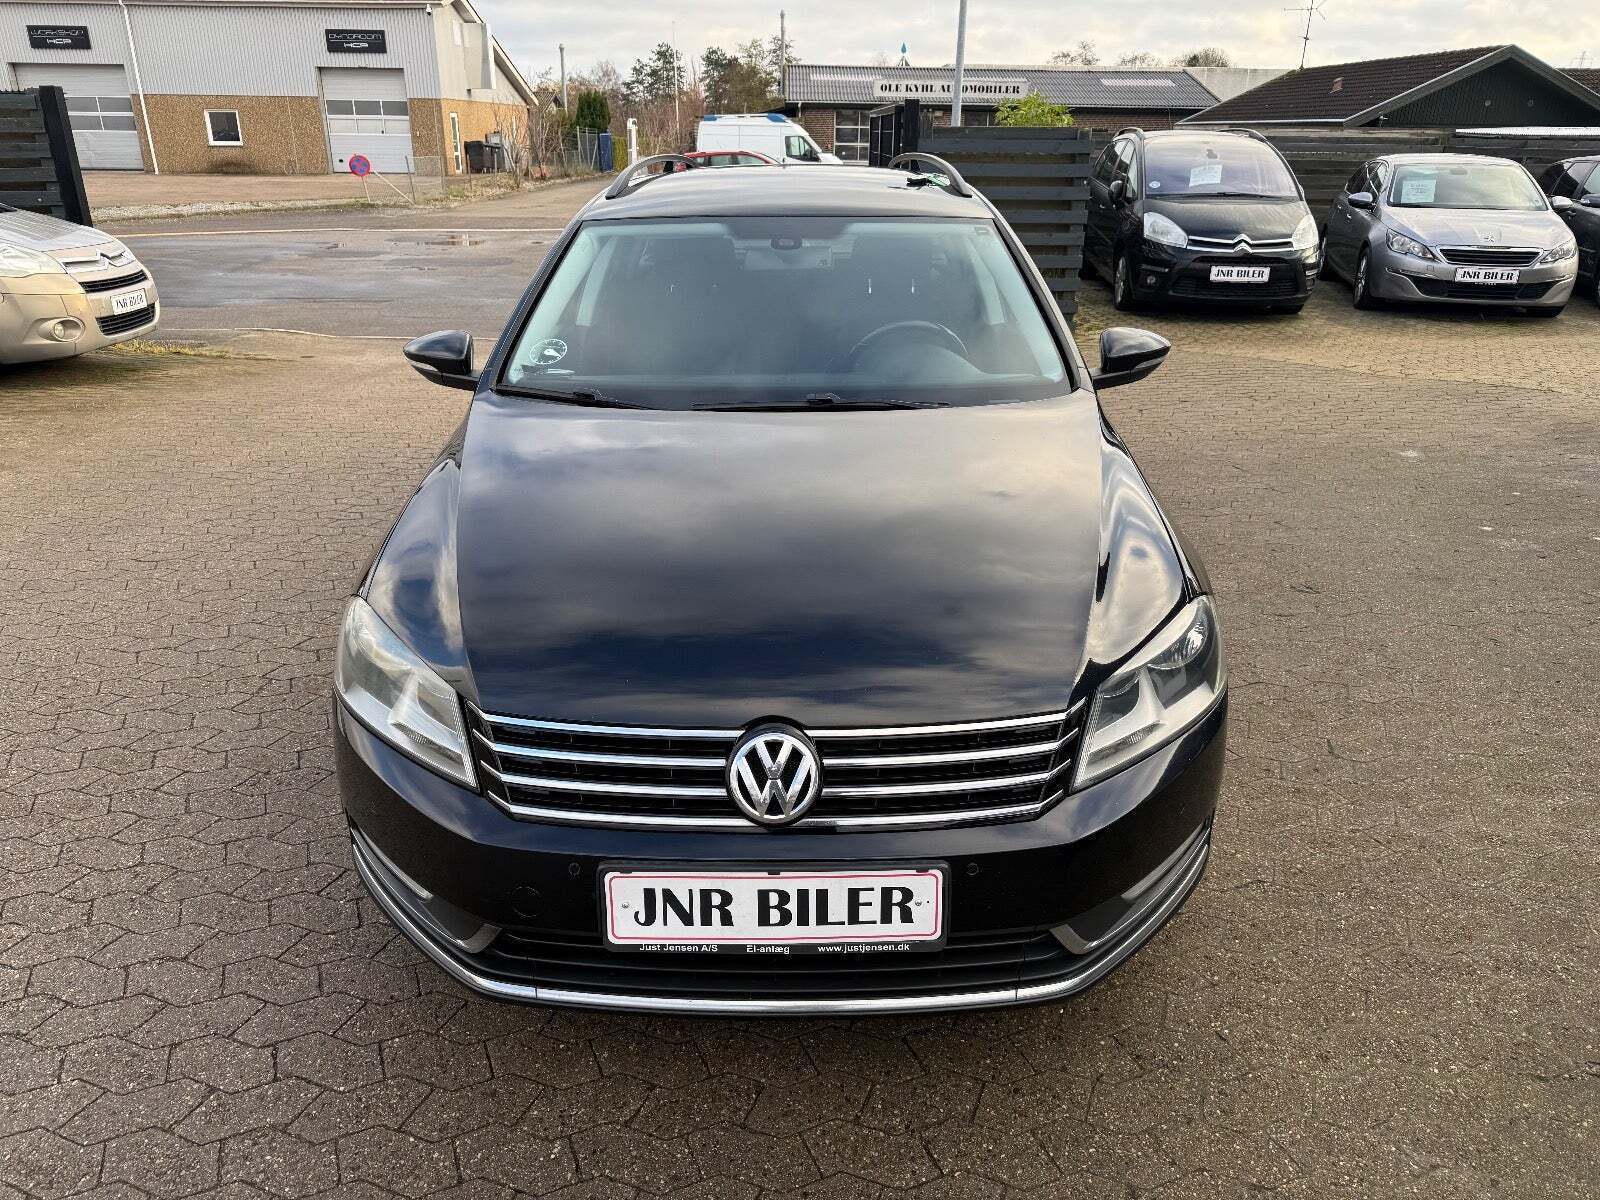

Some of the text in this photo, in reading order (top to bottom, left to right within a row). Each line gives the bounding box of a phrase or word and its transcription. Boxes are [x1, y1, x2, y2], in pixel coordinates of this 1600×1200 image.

[880, 83, 1020, 94] OLE KYHL AUOMOBILER
[1214, 269, 1265, 279] JNR BILER
[1461, 270, 1514, 280] JNR BILER
[634, 886, 914, 927] JNR BILER
[640, 944, 718, 952] Just Jensen A/S
[818, 942, 910, 954] www.justjensen.dk
